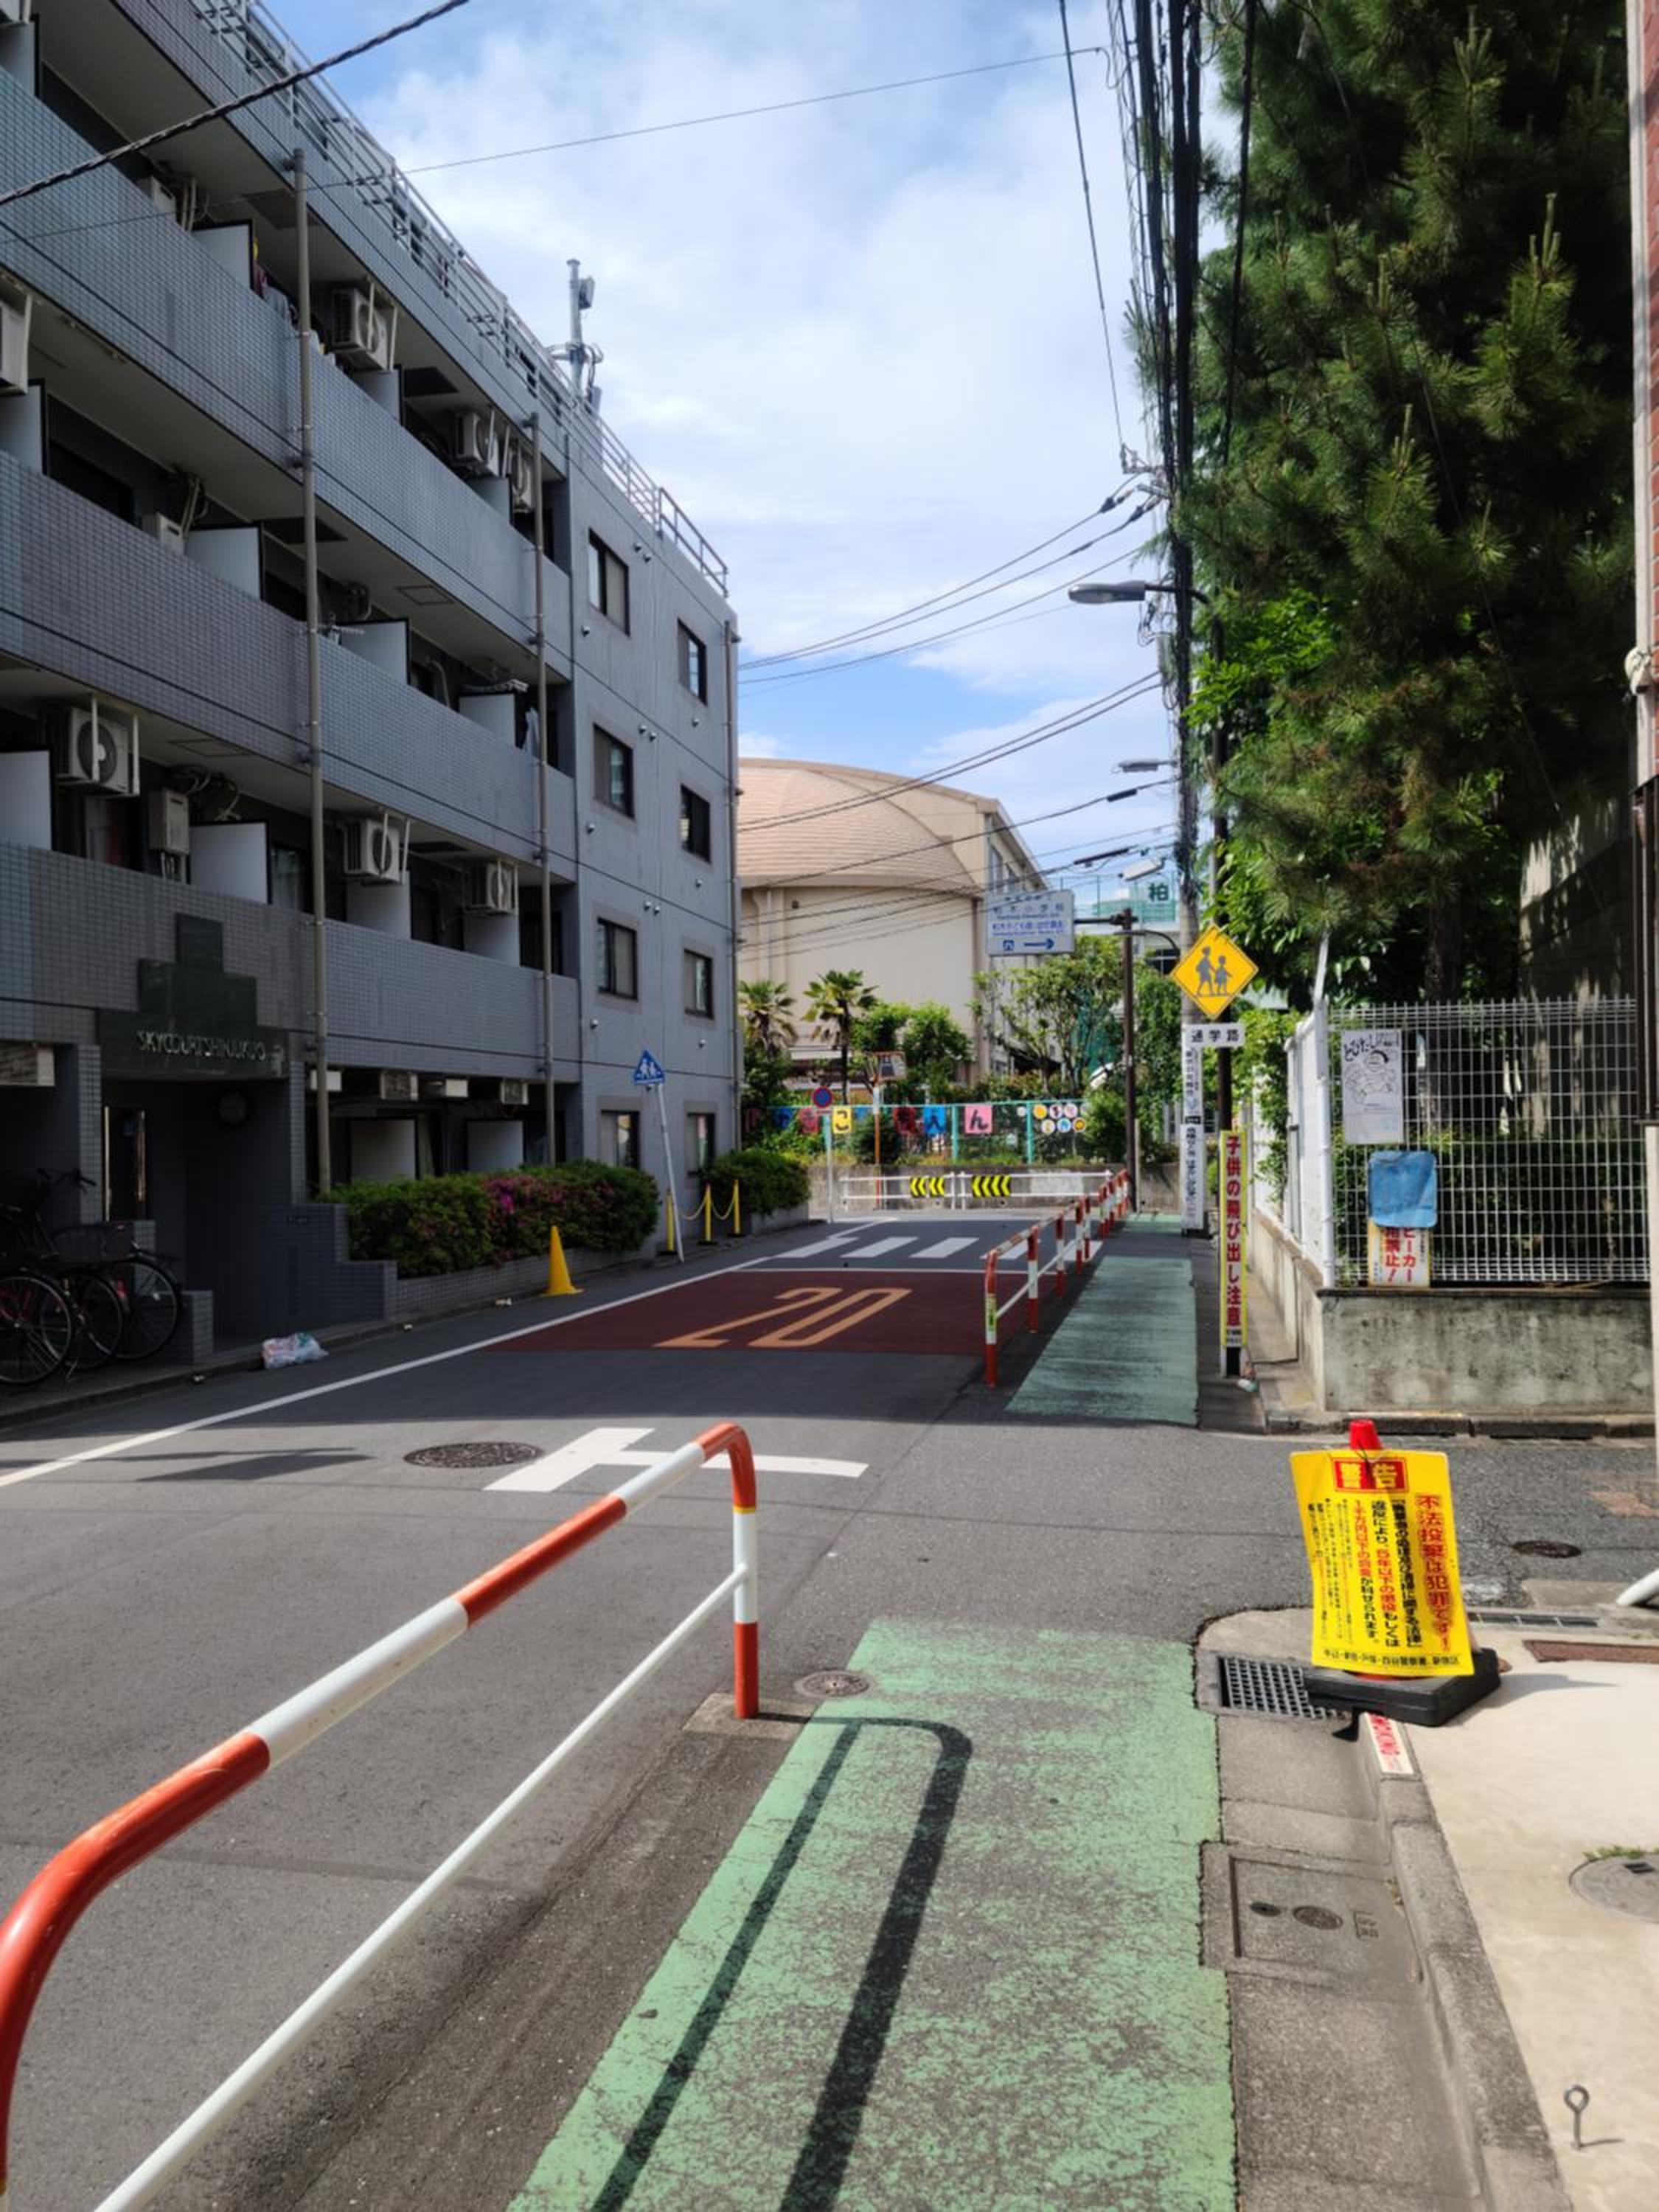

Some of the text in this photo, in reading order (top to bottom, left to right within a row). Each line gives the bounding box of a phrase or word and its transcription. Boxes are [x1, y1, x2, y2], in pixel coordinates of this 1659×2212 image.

[1191, 1029, 1239, 1043] 通学路
[970, 1109, 989, 1130] ん
[652, 1287, 913, 1348] 20
[1339, 1461, 1397, 1489] 警告
